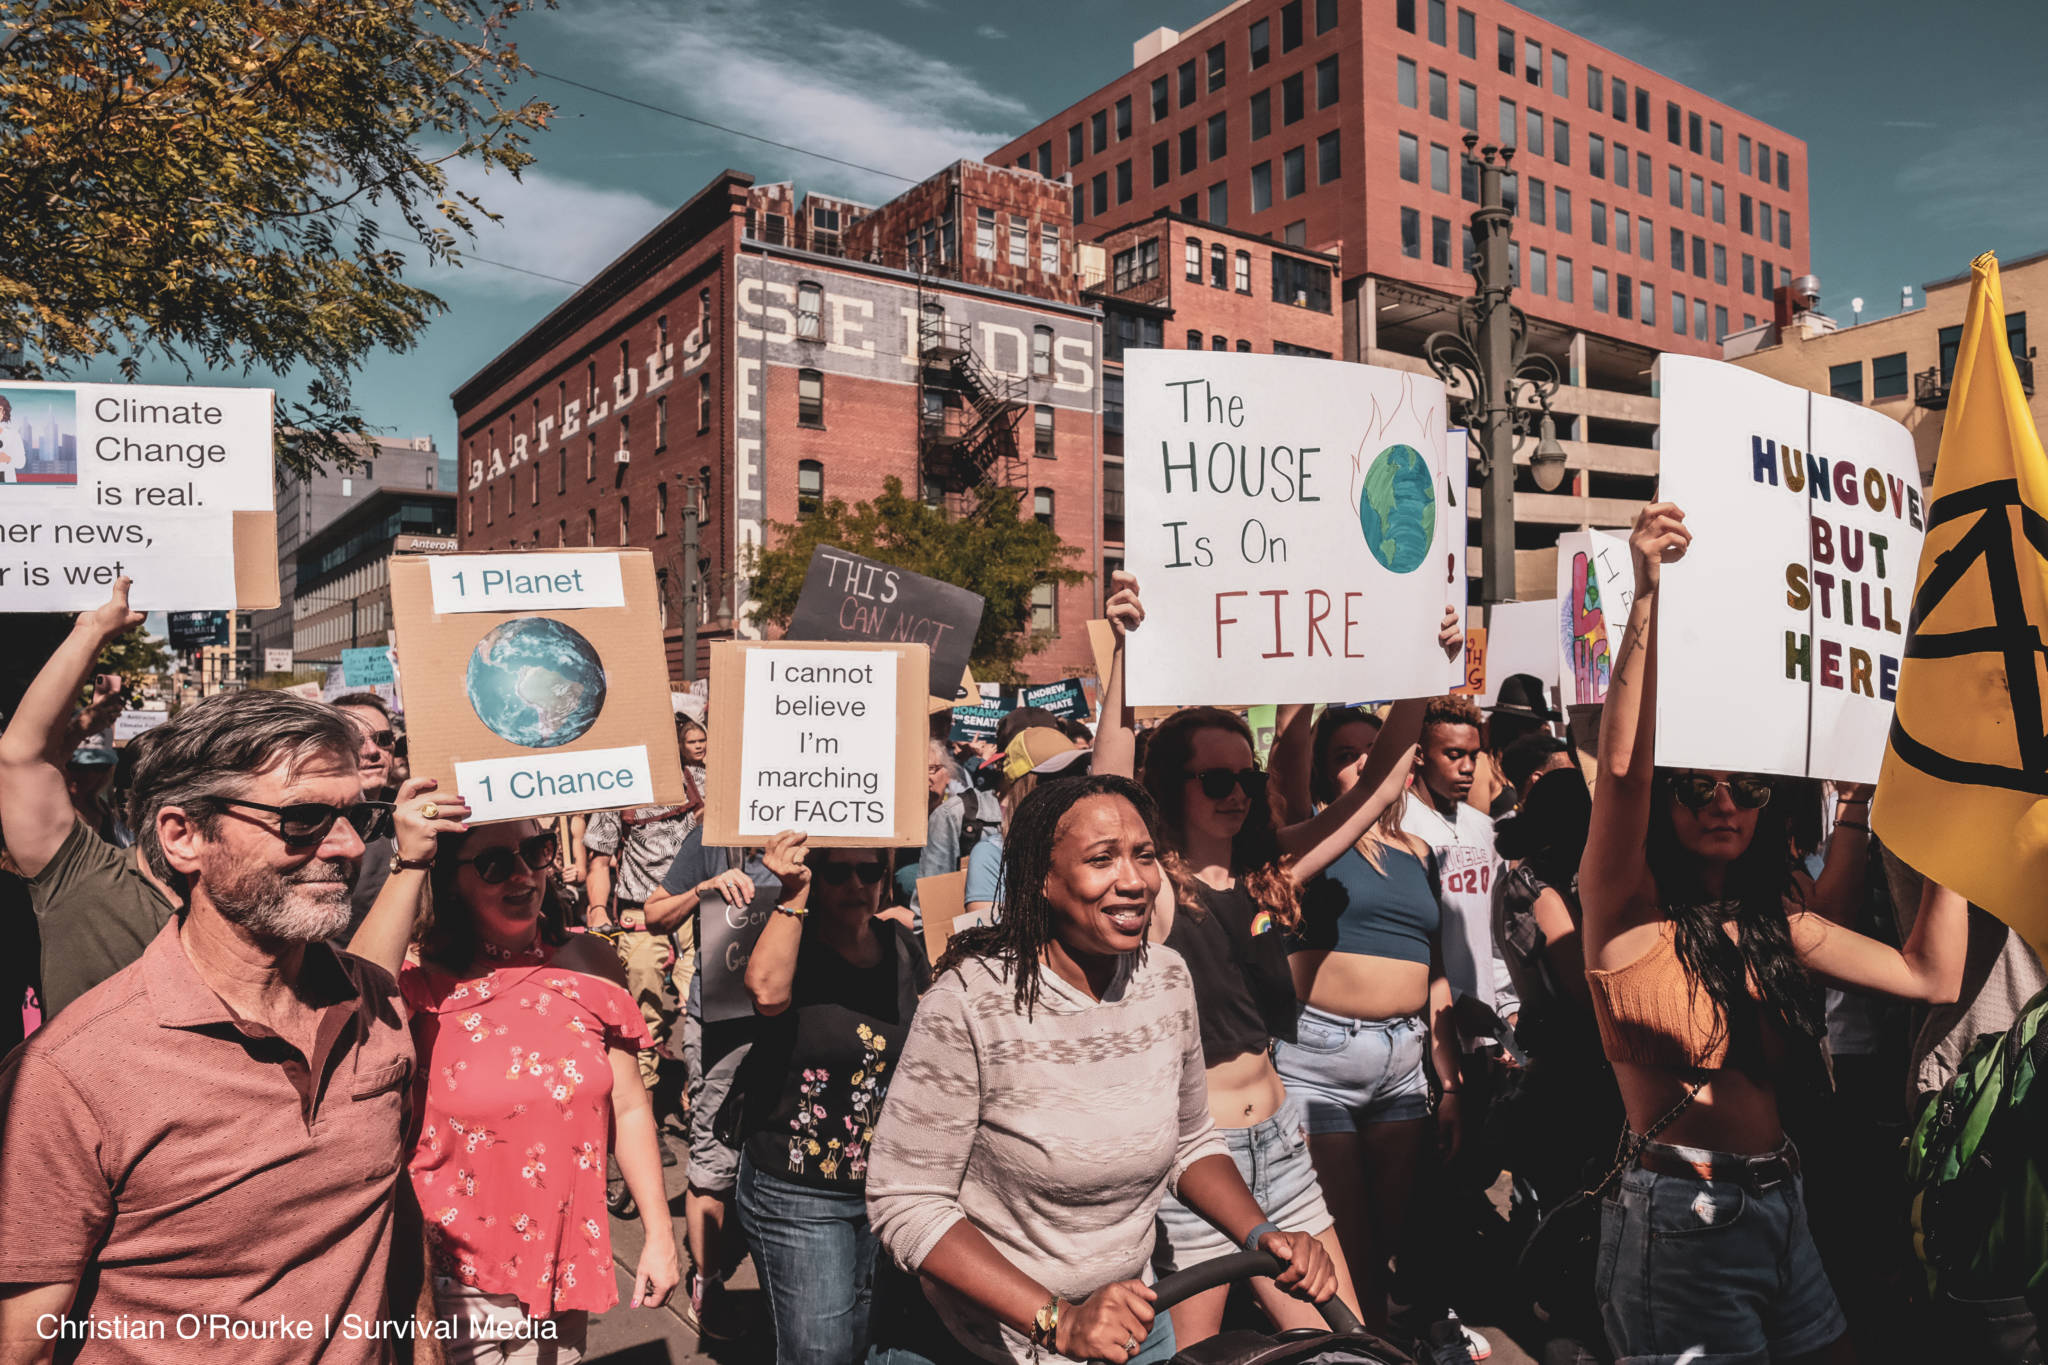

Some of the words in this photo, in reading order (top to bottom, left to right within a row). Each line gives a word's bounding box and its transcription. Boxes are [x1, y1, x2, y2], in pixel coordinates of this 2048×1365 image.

[94, 397, 223, 425] Climate
[468, 325, 712, 491] BARTELDES
[1165, 378, 1245, 428] The
[95, 436, 226, 469] Change
[1162, 440, 1321, 503] HOUSE
[97, 480, 123, 506] is
[135, 482, 203, 507] real.
[55, 525, 153, 549] news,
[410, 539, 446, 550] Antero
[1162, 521, 1214, 569] Is
[1241, 518, 1287, 564] On
[1811, 516, 1889, 580] BUT
[23, 560, 50, 587] is
[452, 571, 465, 597] 1
[482, 569, 584, 596] Planet
[822, 553, 900, 603] THIS
[1786, 562, 1902, 636] STILL
[840, 596, 887, 635] CAN
[890, 612, 955, 655] NOT
[1216, 588, 1365, 660] FIRE
[770, 660, 775, 682] I
[785, 664, 873, 684] cannot
[1786, 630, 1899, 703] HERE
[775, 694, 866, 717] believe
[1028, 683, 1066, 700] ANDREW
[1028, 689, 1078, 707] ROMANOFF
[800, 731, 838, 754] I’m
[479, 775, 493, 803] 1
[509, 768, 634, 799] Chance
[758, 766, 878, 795] marching
[749, 799, 786, 822] for
[794, 800, 885, 824] FACTS
[1440, 865, 1490, 895] 020
